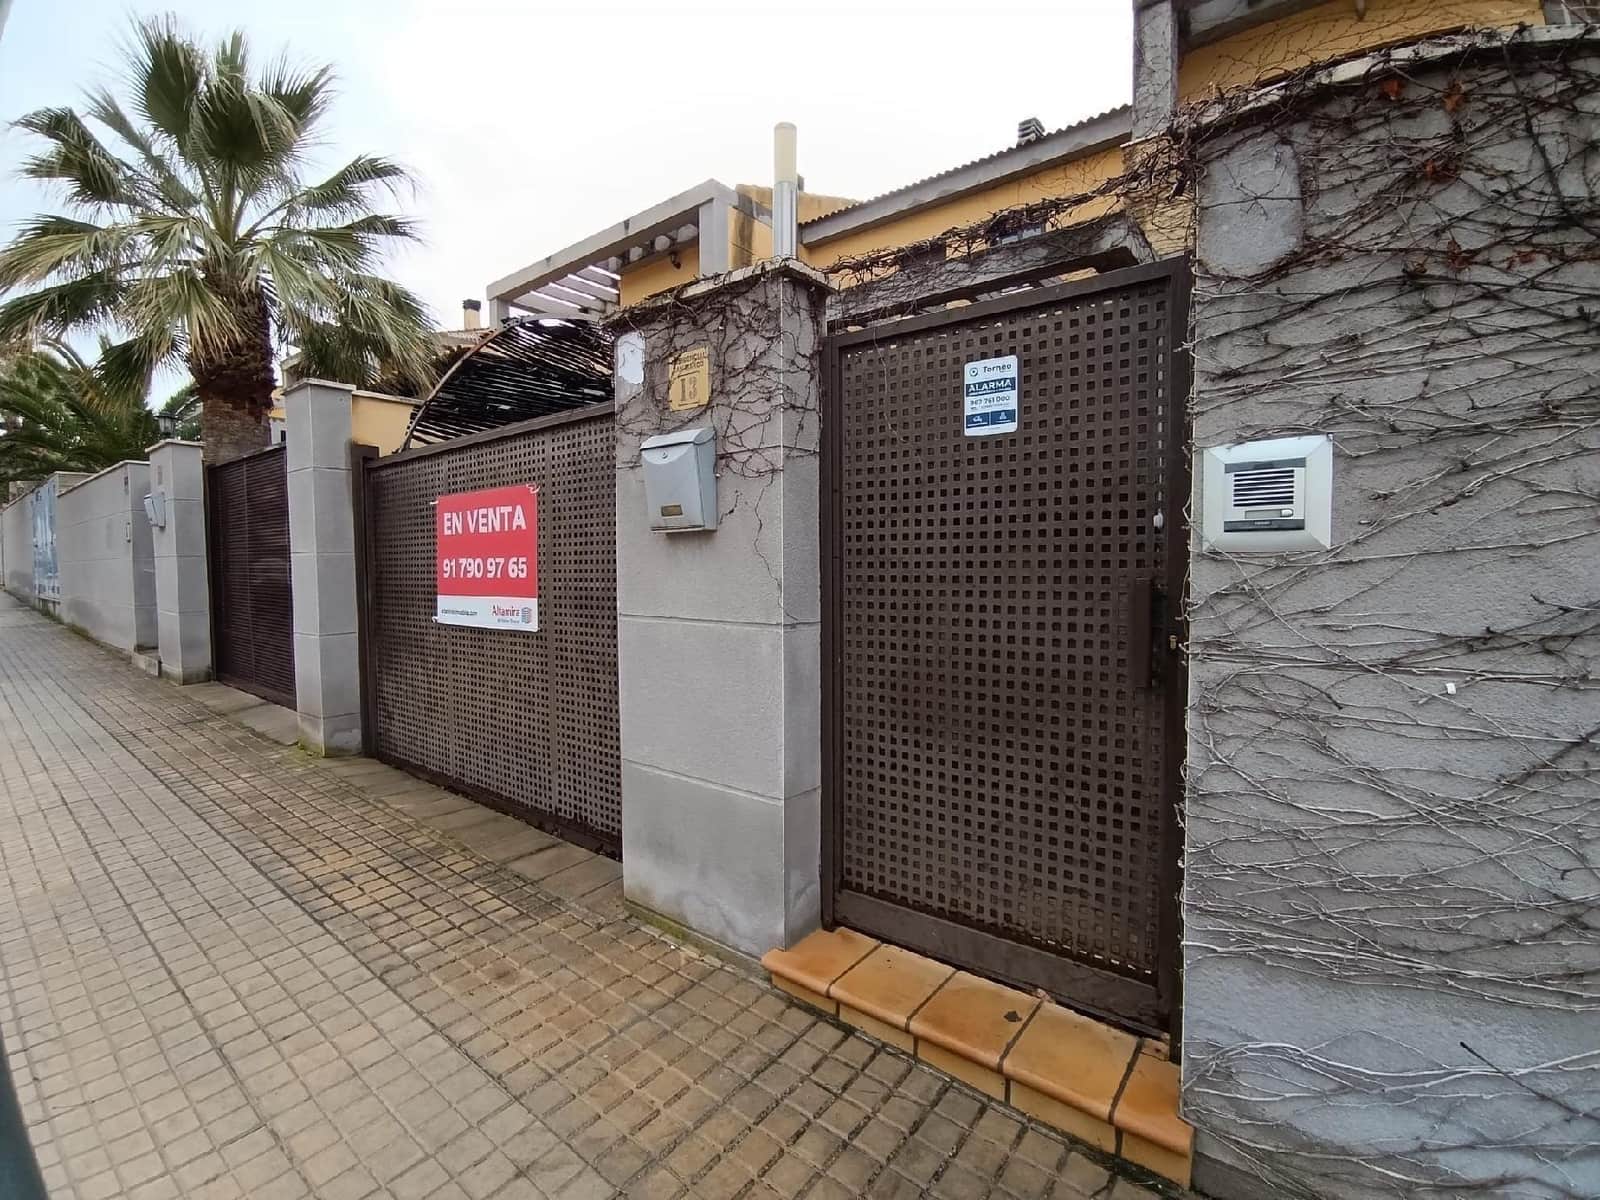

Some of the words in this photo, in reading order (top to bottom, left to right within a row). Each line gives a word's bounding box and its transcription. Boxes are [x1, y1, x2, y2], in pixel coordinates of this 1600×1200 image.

[983, 363, 1012, 373] Torneo
[968, 379, 1012, 392] ALARMA
[443, 511, 463, 535] EN
[466, 505, 527, 533] VENTA
[443, 558, 456, 578] 91
[459, 557, 483, 578] 790
[486, 557, 505, 578] 97
[508, 557, 528, 578] 65
[492, 604, 520, 616] Altamira
